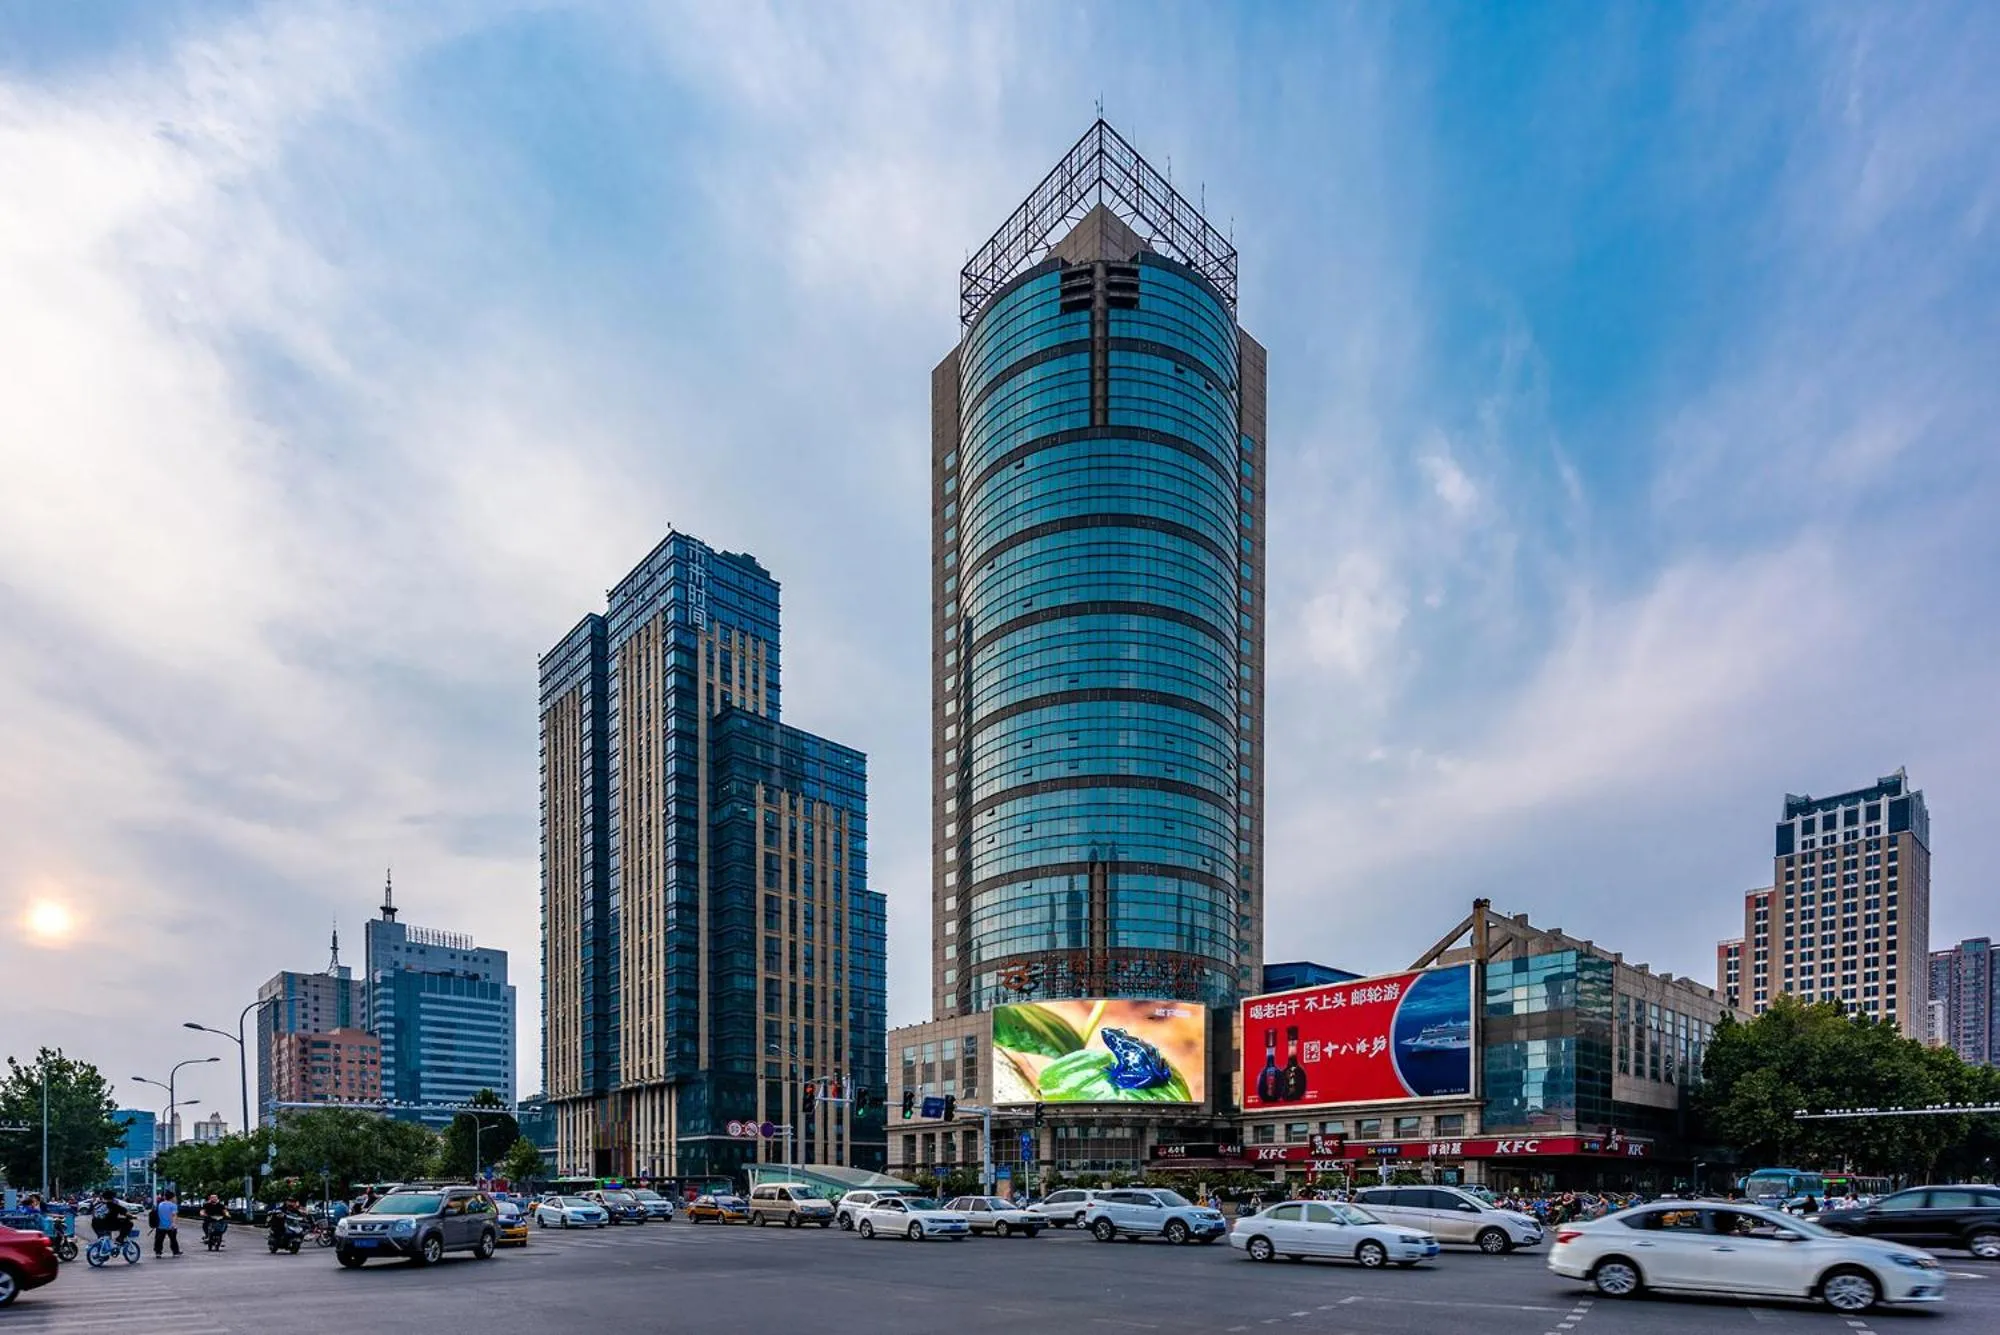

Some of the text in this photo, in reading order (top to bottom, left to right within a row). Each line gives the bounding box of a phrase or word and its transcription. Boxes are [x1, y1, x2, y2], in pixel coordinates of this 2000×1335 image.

[1250, 982, 1400, 1019] 喝老白干 不上头 邮轮游
[1323, 1139, 1340, 1147] KFC
[1495, 1139, 1540, 1154] KFC
[1627, 1143, 1644, 1156] KFC
[1257, 1148, 1288, 1160] KFC
